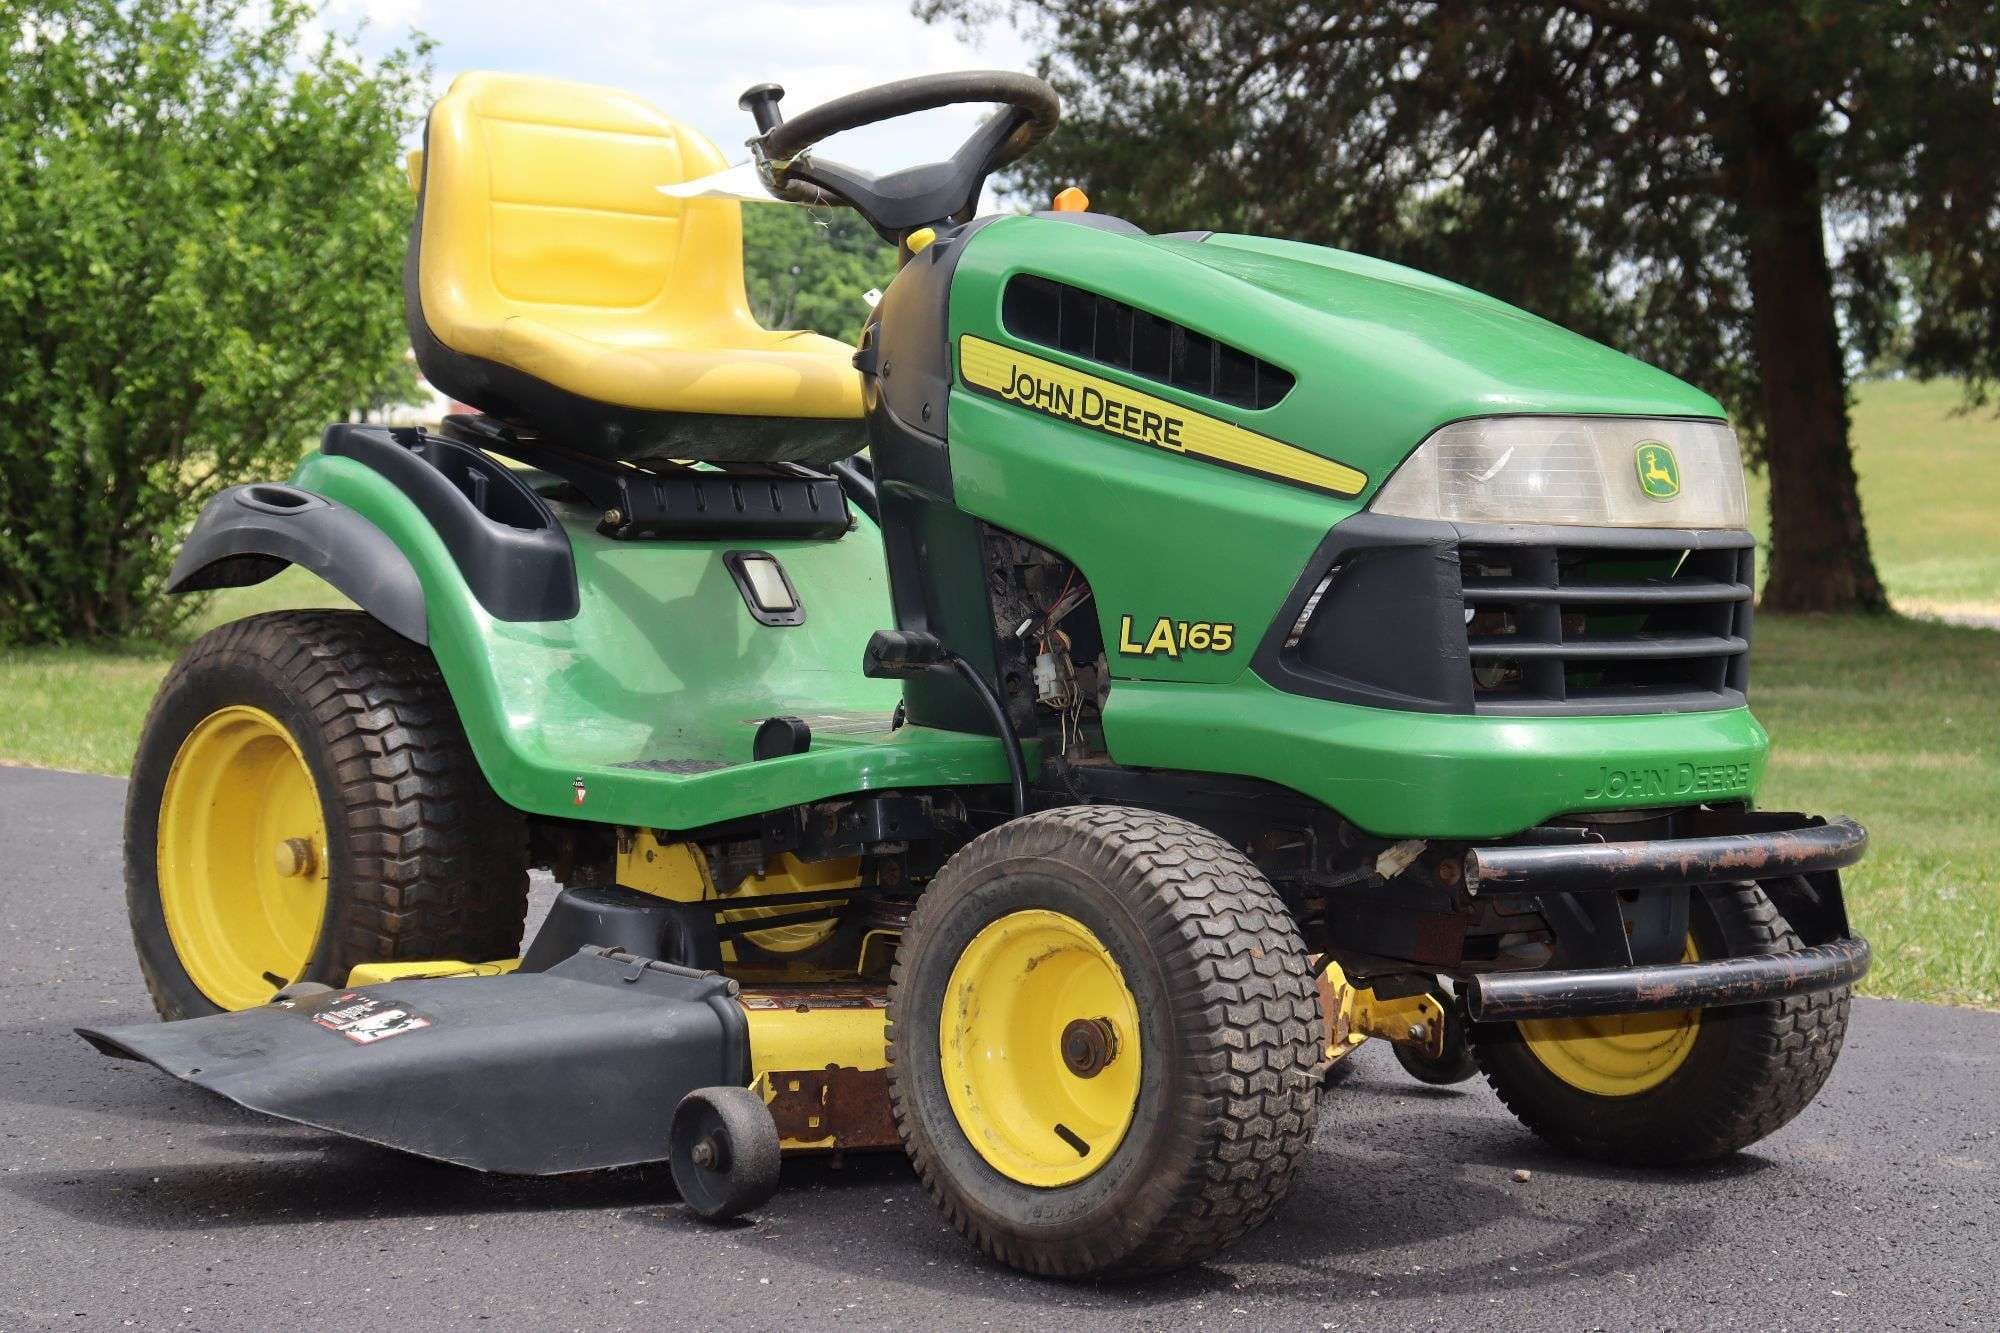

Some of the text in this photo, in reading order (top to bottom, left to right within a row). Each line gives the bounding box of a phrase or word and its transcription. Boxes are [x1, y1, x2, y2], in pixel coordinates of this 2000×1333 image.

[1001, 364, 1184, 447] JOHN DEERE
[1119, 614, 1234, 658] LA165
[1584, 762, 1750, 799] JOHN DEERE
